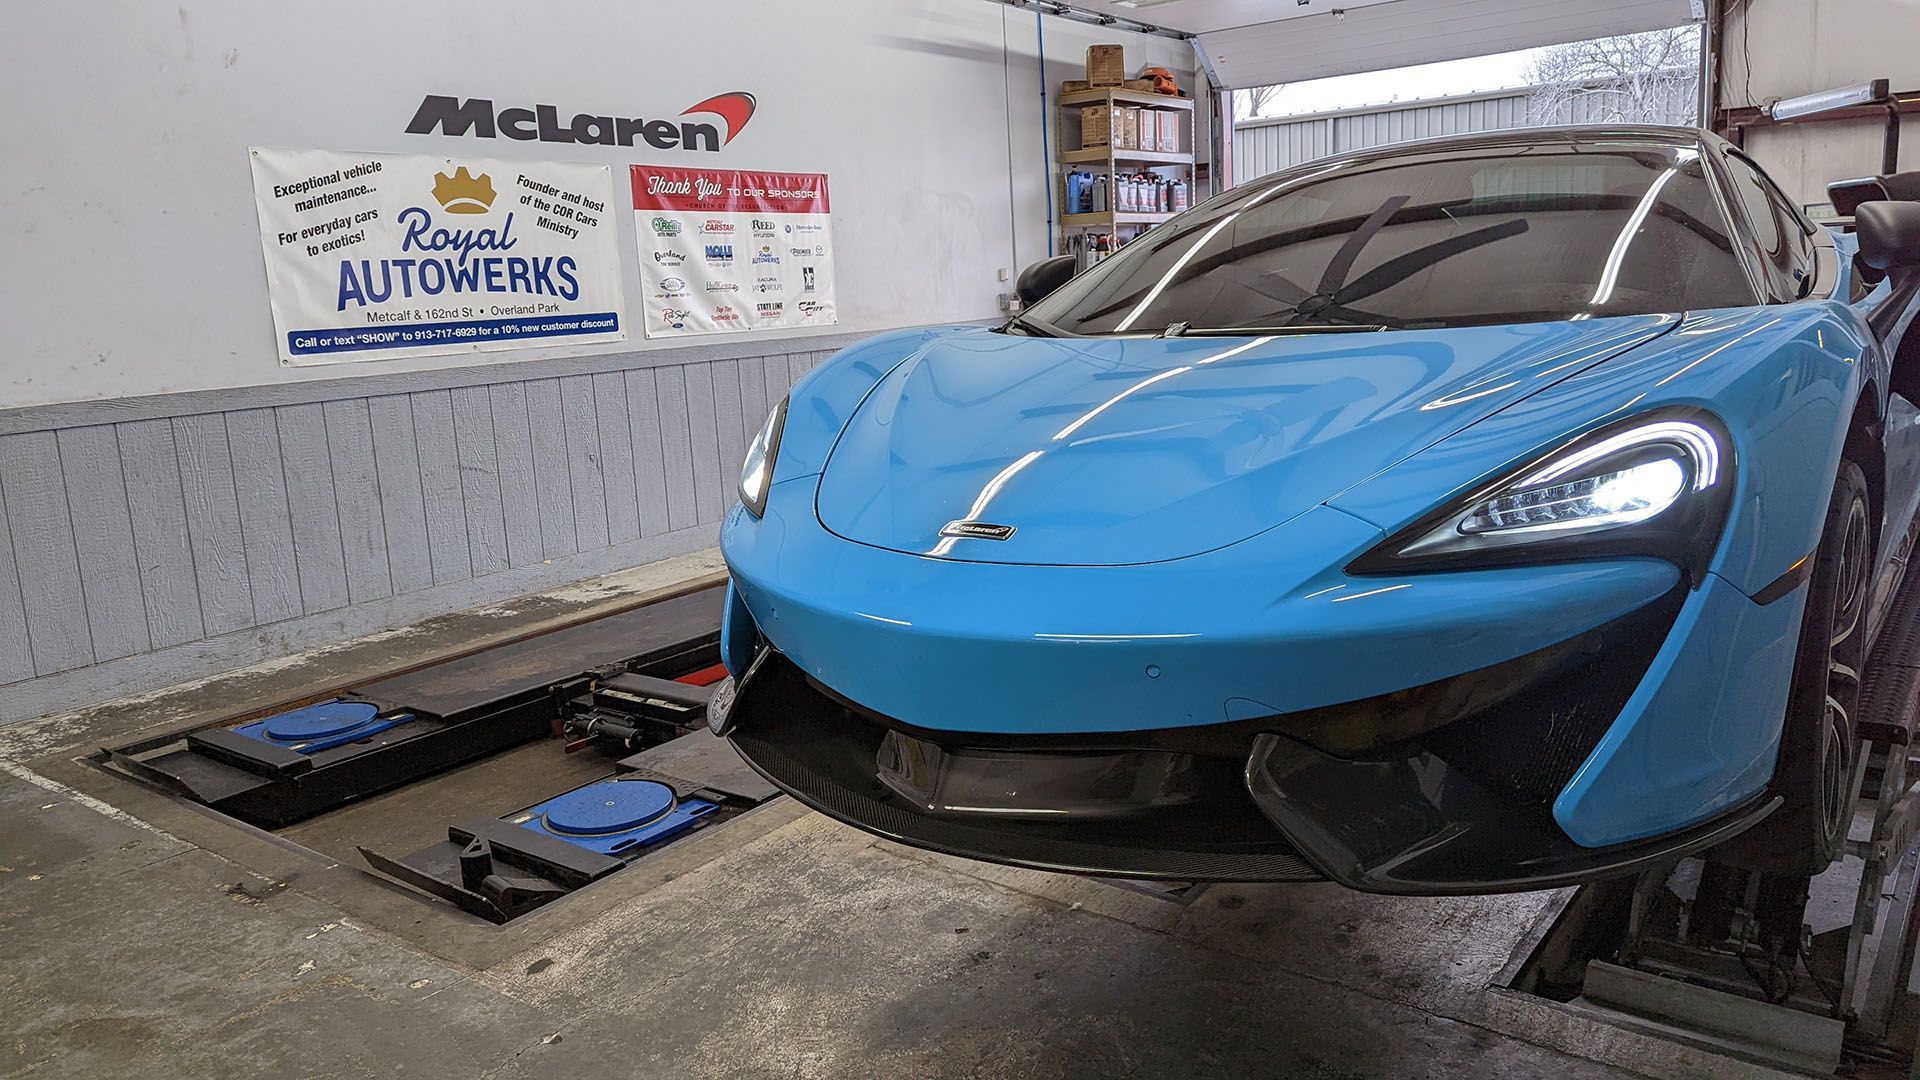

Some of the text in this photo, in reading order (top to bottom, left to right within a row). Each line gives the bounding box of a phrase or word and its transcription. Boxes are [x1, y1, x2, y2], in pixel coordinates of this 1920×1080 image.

[404, 95, 720, 152] McLaren
[273, 161, 382, 198] Exceptional vehicle
[516, 174, 605, 213] Founder and host
[647, 176, 820, 200] Thank You TO OUR SPONSORS
[294, 184, 377, 213] maintenance...
[520, 195, 598, 227] of the COR Cars
[278, 209, 378, 246] For everyday cars
[397, 207, 518, 267] Royal
[536, 216, 579, 240] Ministry
[705, 223, 735, 231] CARSTAR
[752, 220, 776, 231] REED
[306, 229, 366, 257] to exotics!
[654, 250, 686, 261] Overland
[337, 256, 579, 312] AUTOWERKS
[367, 303, 561, 323] Metcalf & 162nd St Overland Park
[757, 302, 771, 311] STATE
[295, 337, 317, 348] Call
[320, 338, 332, 347] or
[334, 335, 355, 346] text
[402, 331, 413, 341] to
[414, 327, 477, 340] 913-717-6929
[478, 326, 491, 336] for
[501, 324, 520, 334] 10%
[521, 325, 539, 333] new
[541, 321, 579, 331] customer
[581, 318, 615, 328] discount
